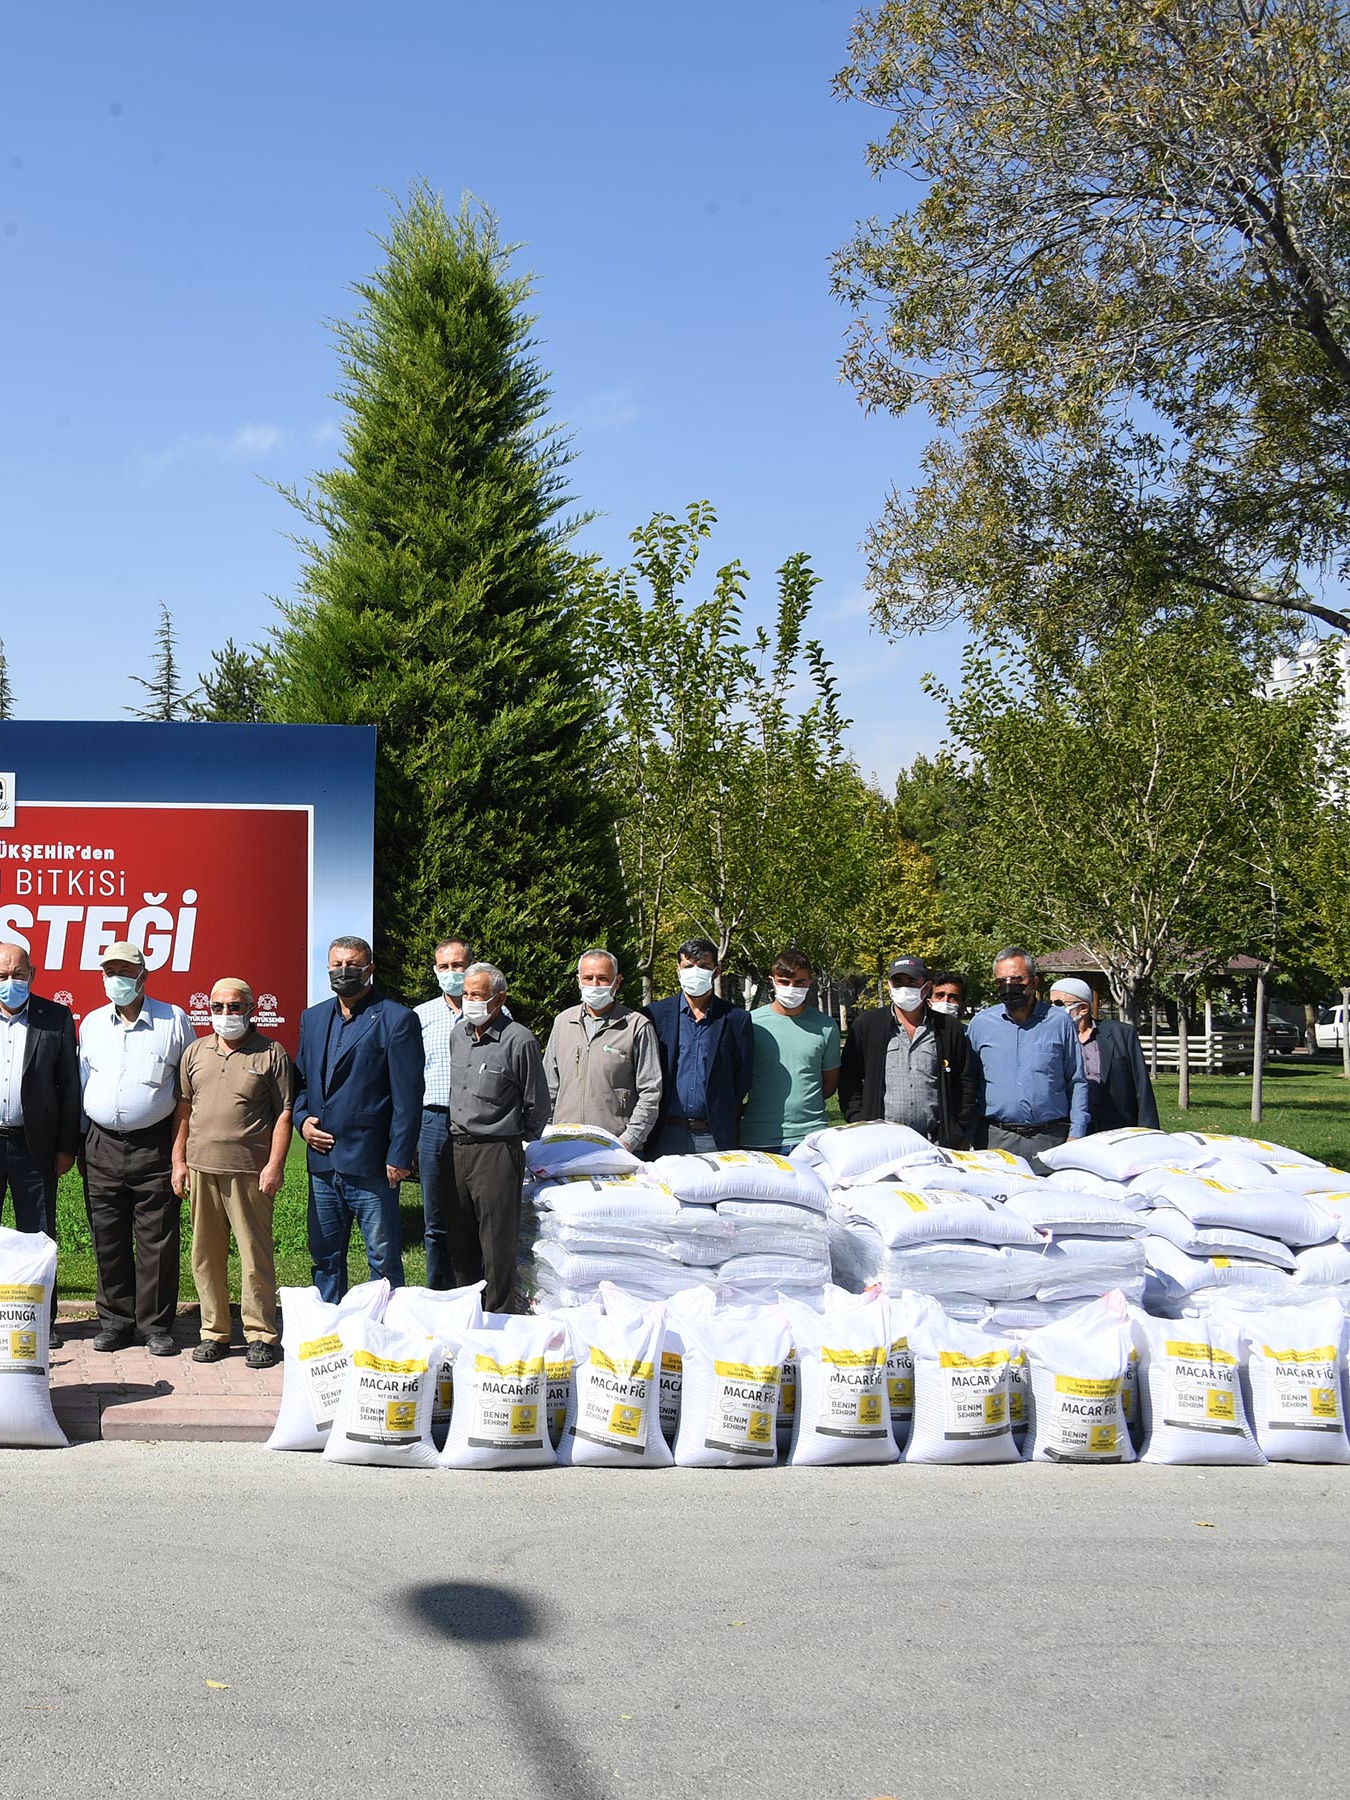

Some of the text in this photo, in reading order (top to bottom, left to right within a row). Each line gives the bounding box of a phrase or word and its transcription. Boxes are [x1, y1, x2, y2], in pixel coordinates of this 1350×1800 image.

[311, 1358, 348, 1377] MACAR
[1176, 1366, 1216, 1379] MACAR
[1276, 1367, 1315, 1378] MACAR
[360, 1377, 399, 1391] MACAR
[591, 1376, 627, 1394] MACAR
[830, 1373, 870, 1385] MACAR
[952, 1376, 991, 1386] MACAR
[483, 1382, 522, 1395] MACAR
[724, 1386, 762, 1401] MACAR
[1062, 1403, 1102, 1416] MACAR
